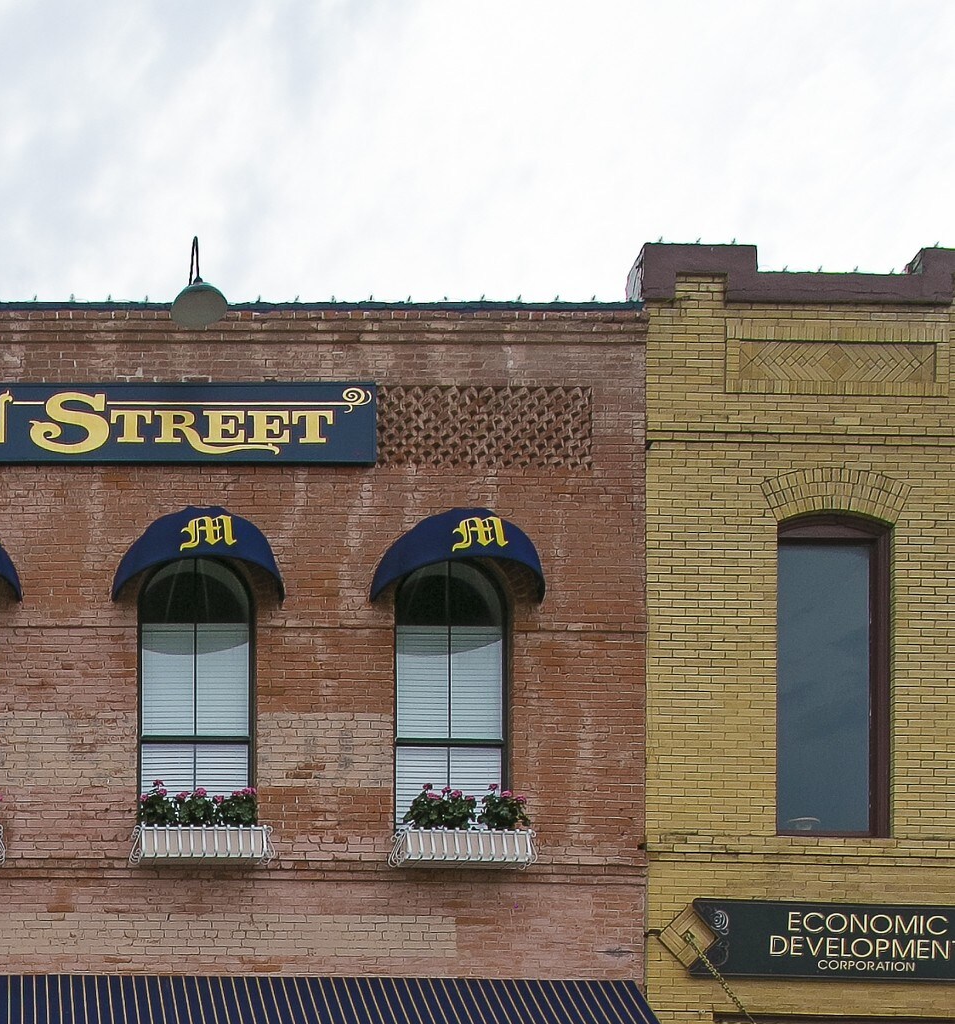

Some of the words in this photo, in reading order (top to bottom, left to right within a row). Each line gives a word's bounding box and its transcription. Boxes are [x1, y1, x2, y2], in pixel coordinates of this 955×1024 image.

[181, 515, 234, 548] M
[453, 517, 507, 549] M
[787, 911, 948, 936] ECONOMIC
[769, 935, 955, 960] DEVELOPMEN
[817, 959, 916, 972] CORPORATION
